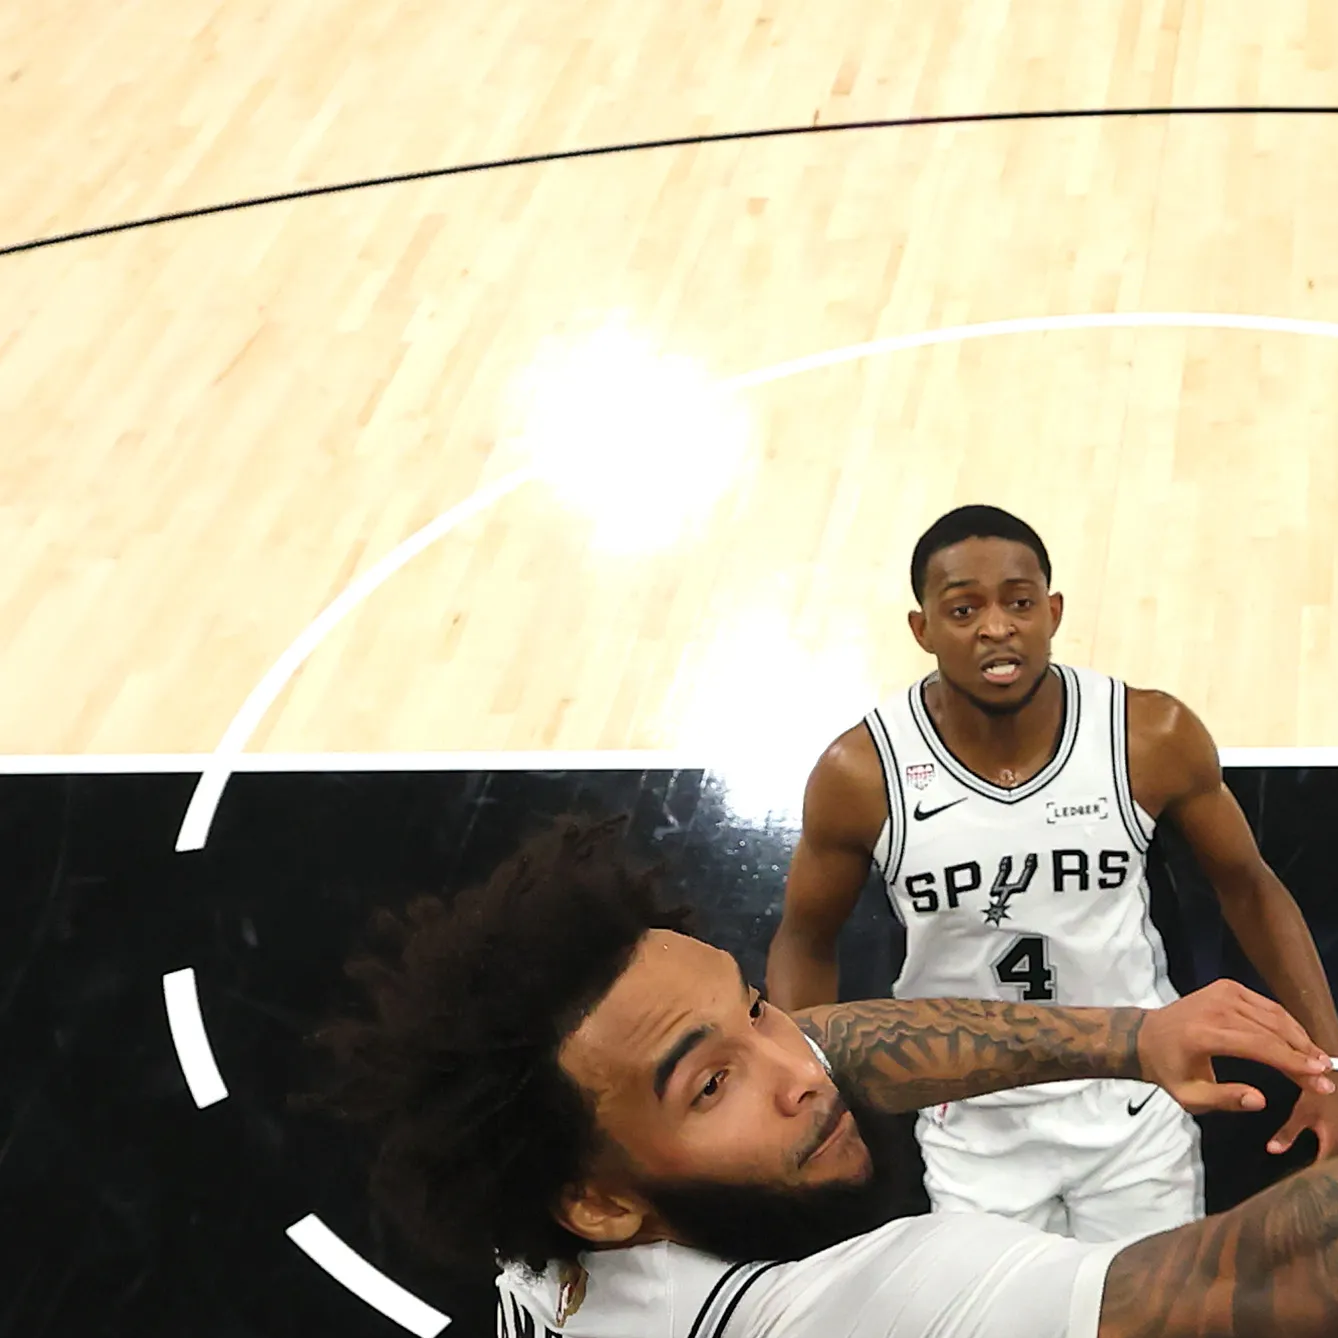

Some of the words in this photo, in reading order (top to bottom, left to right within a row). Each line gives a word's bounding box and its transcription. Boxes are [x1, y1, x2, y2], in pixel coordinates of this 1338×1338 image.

[1054, 804, 1100, 818] LEDGER
[904, 850, 1129, 928] SPURS
[991, 932, 1057, 1003] 4
